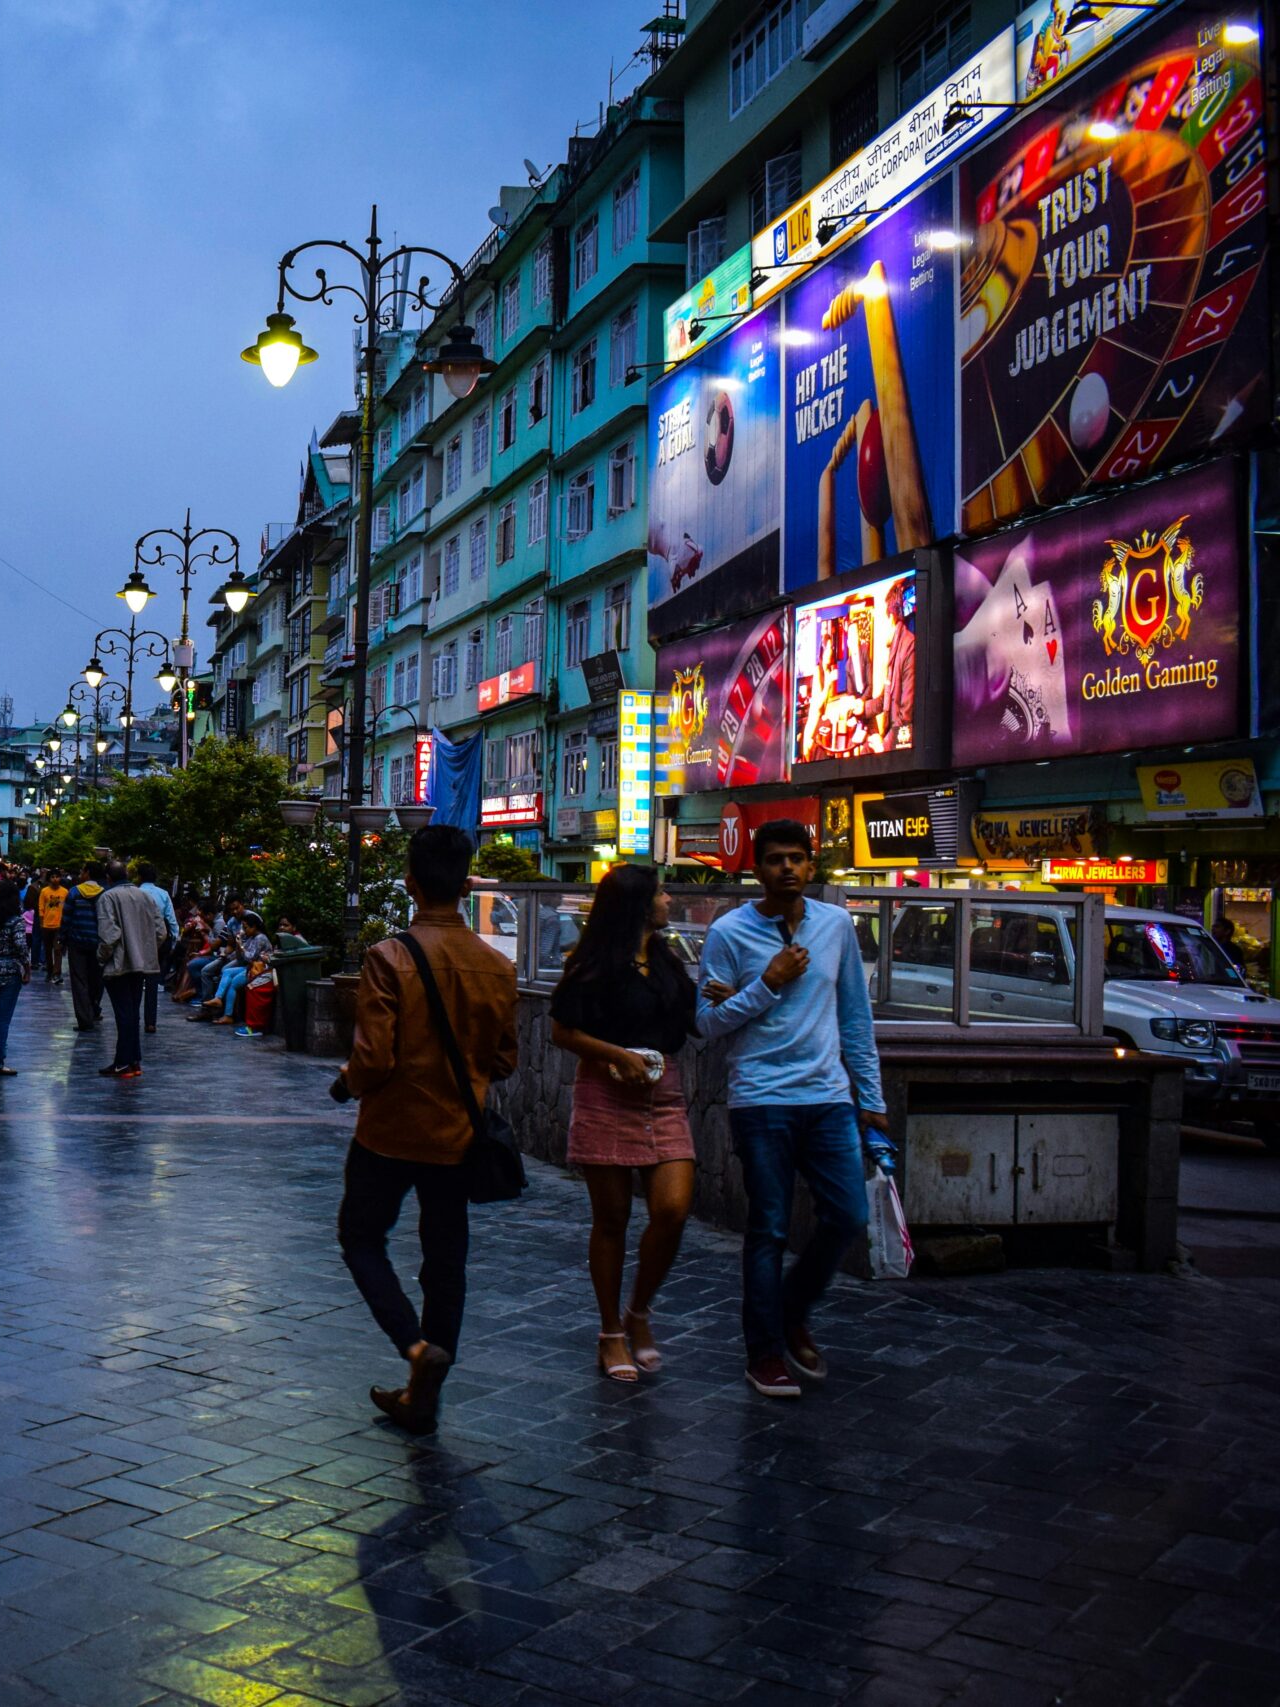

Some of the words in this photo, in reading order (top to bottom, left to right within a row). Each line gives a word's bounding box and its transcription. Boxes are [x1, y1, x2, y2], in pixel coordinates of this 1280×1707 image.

[1198, 22, 1220, 48] Live
[1195, 47, 1226, 76] Legal
[1191, 70, 1231, 106] Betting
[820, 164, 860, 205] भारतीय
[867, 131, 901, 168] जीवन
[908, 102, 936, 132] बीमा
[944, 63, 982, 106] निगम
[836, 170, 880, 215] INSURANCE
[881, 120, 940, 180] CORPORATION
[1038, 156, 1112, 240] TRUST
[790, 208, 808, 251] LIC
[910, 267, 934, 291] Betting
[1043, 224, 1110, 298] YOUR
[1008, 264, 1152, 377] JUDGEMENT
[796, 362, 818, 405] HIT
[820, 344, 848, 389] THE
[658, 396, 691, 440] STRIKE
[796, 386, 845, 444] WICKET
[659, 443, 667, 467] A
[669, 424, 696, 461] GOAL
[1014, 584, 1027, 619] A
[1130, 568, 1160, 626] G
[1043, 599, 1057, 636] A
[763, 630, 780, 661] 12
[1082, 667, 1141, 700] Golden
[1145, 654, 1218, 689] Gaming
[682, 690, 693, 725] G
[734, 685, 746, 709] 7
[686, 745, 712, 766] Gaming
[869, 820, 903, 838] TITAN
[1016, 817, 1088, 838] JEWELLERS
[1053, 865, 1085, 880] TIRWA
[1086, 866, 1146, 880] JEWELLERS
